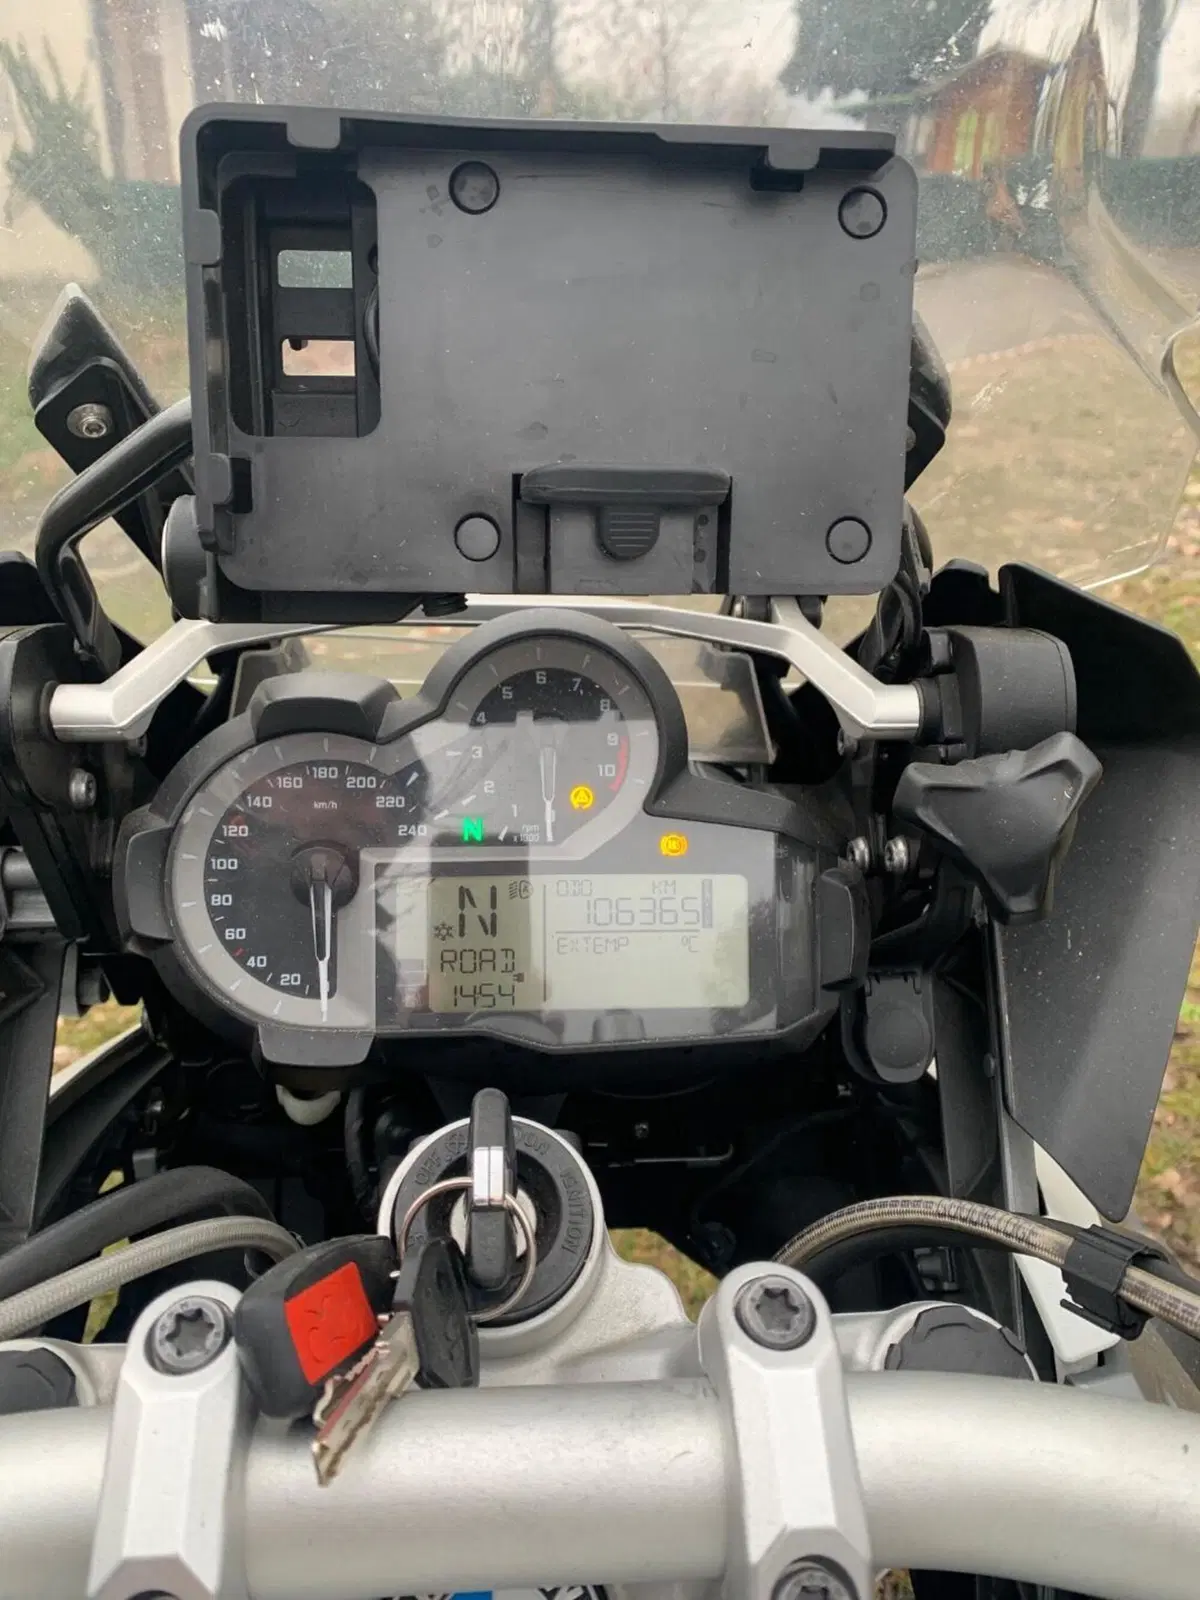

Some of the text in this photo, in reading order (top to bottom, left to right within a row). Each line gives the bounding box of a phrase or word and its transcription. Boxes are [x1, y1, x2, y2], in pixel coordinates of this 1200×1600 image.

[536, 671, 547, 684] 6
[572, 678, 582, 691] 7
[502, 686, 513, 699] 5
[600, 699, 611, 712] 8
[476, 712, 486, 724] 4
[607, 733, 618, 746] 9
[472, 746, 483, 759] 3
[313, 767, 338, 779] 180
[598, 764, 616, 777] 10
[277, 777, 303, 788] 160
[346, 777, 376, 788] 200
[484, 781, 495, 793] 2
[247, 796, 272, 808] 140
[314, 800, 338, 810] km/h
[376, 796, 405, 808] 220
[511, 804, 518, 818] 1
[222, 825, 249, 837] 120
[398, 825, 427, 836] 240
[462, 817, 484, 842] N
[211, 858, 238, 870] 100
[652, 880, 677, 895] KM
[211, 894, 232, 906] 80
[458, 885, 498, 937] N
[586, 897, 701, 926] 106365
[225, 928, 246, 940] 60
[246, 956, 267, 968] 40
[440, 948, 515, 974] ROAD
[280, 974, 301, 986] 20
